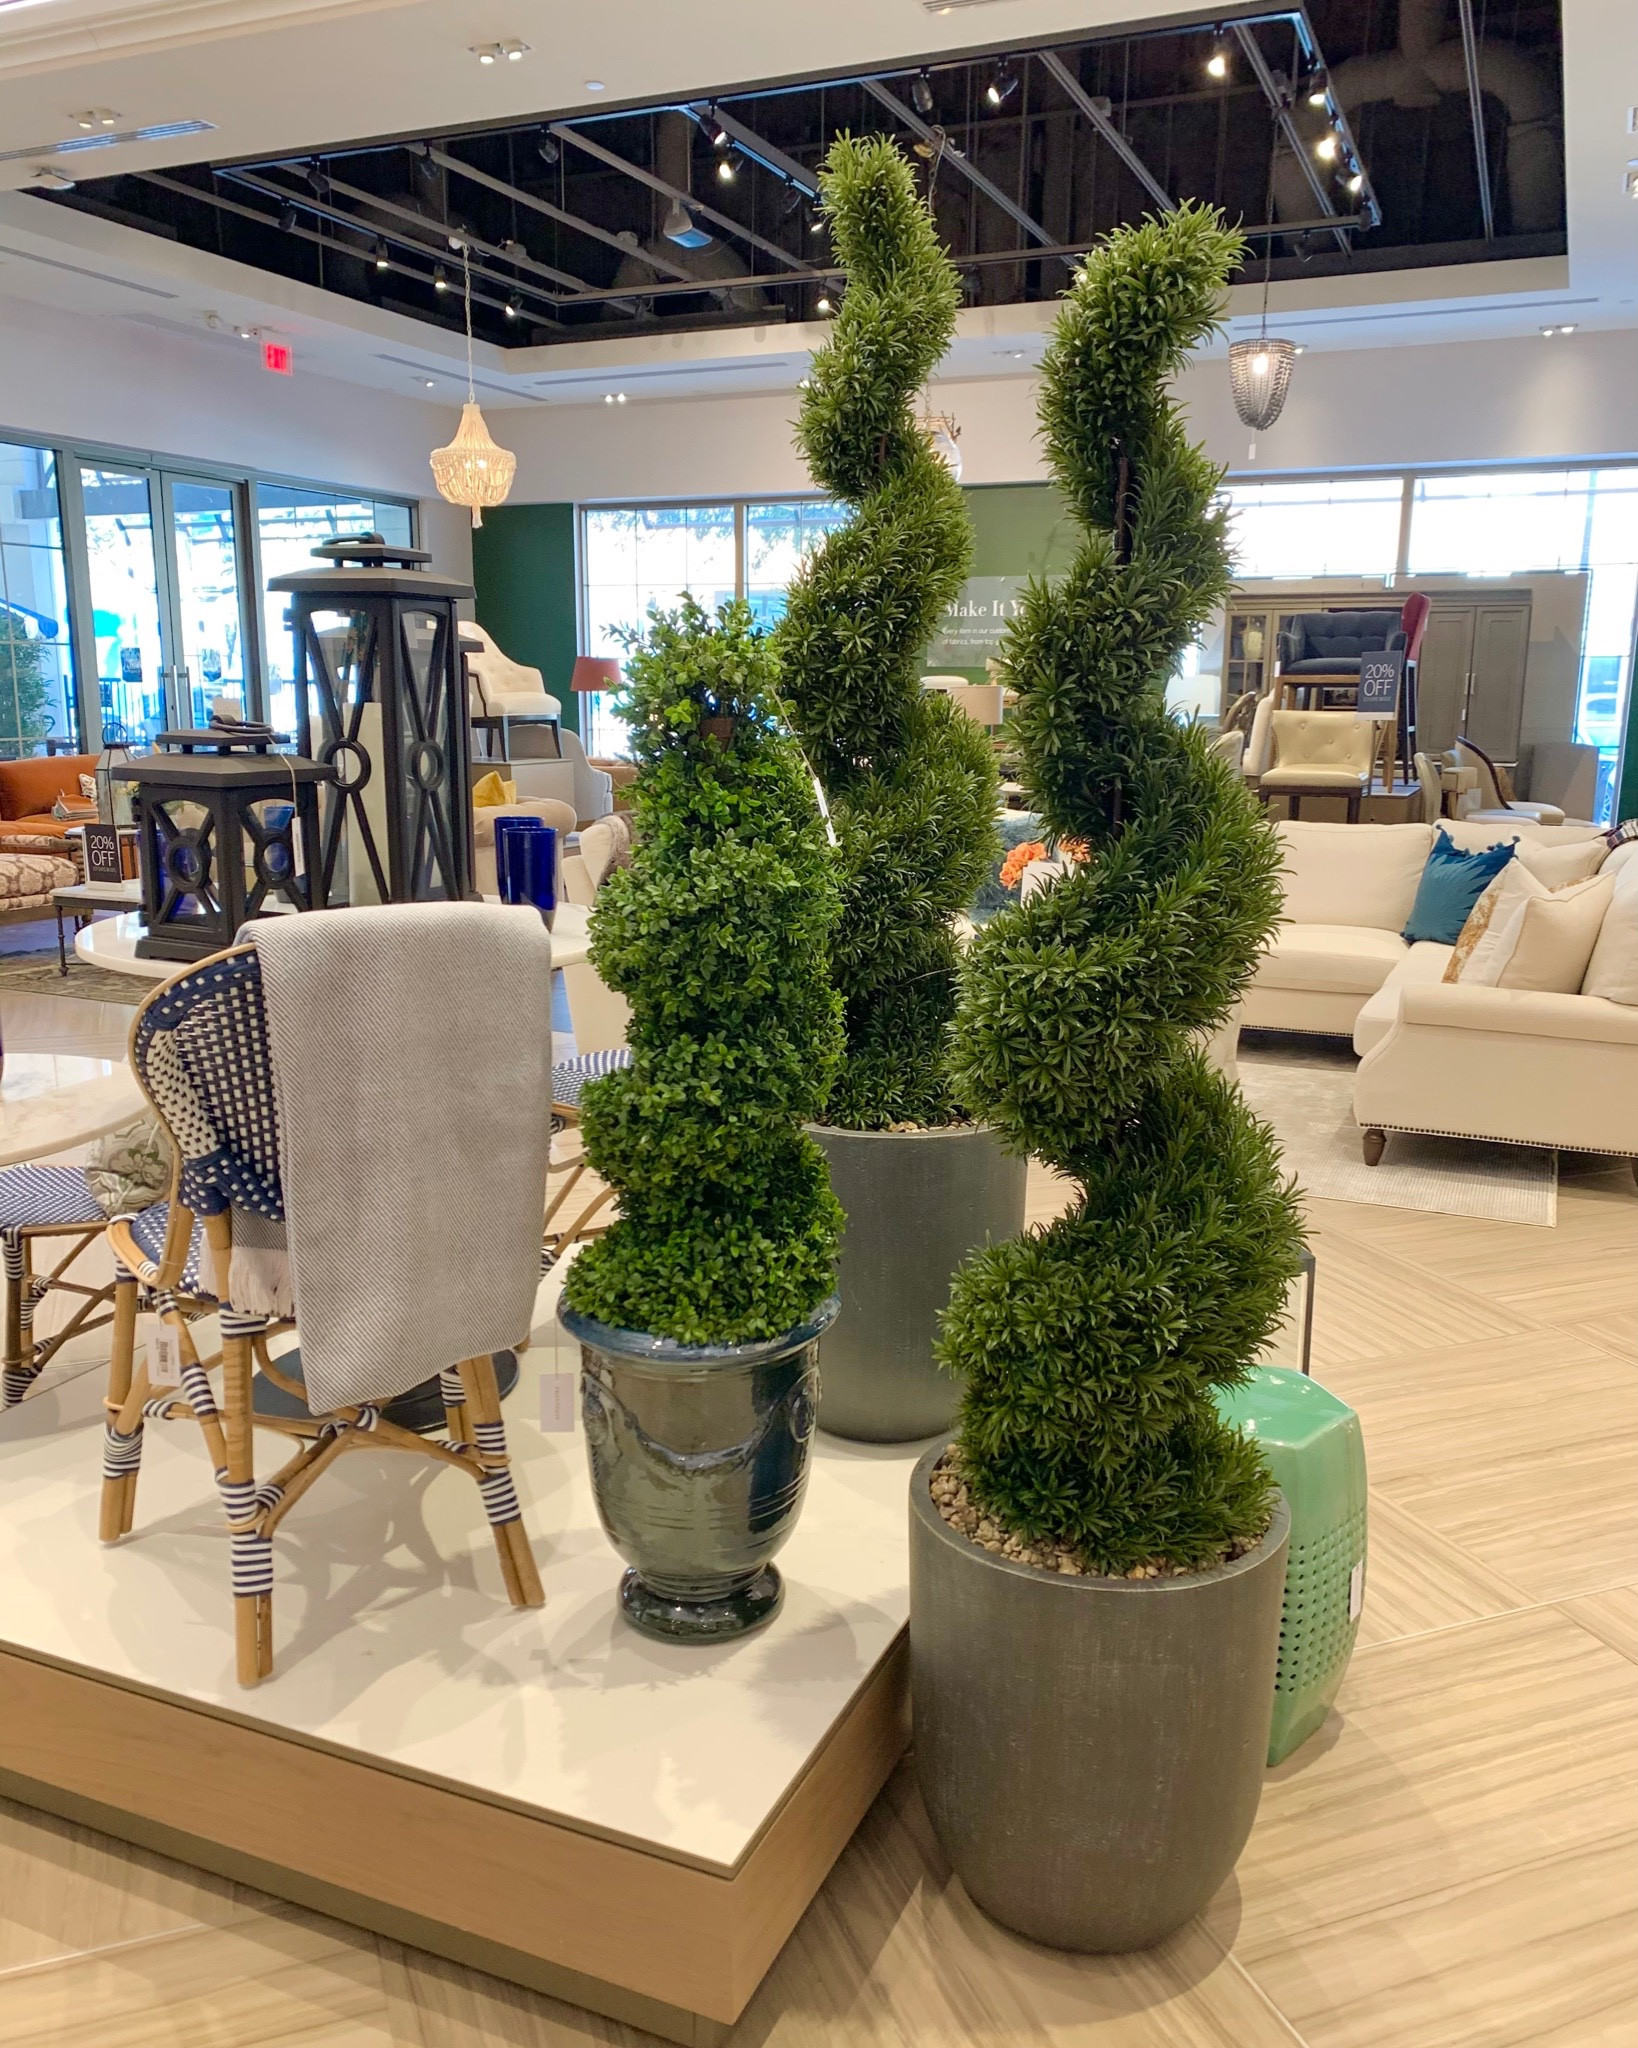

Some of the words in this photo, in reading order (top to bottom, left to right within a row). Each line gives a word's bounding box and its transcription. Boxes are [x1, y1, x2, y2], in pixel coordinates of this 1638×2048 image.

[944, 600, 987, 617] Make
[992, 600, 1005, 617] It
[1365, 664, 1395, 679] 20%
[1363, 680, 1394, 696] OFF
[90, 835, 115, 850] 20%
[91, 850, 115, 867] OFF
